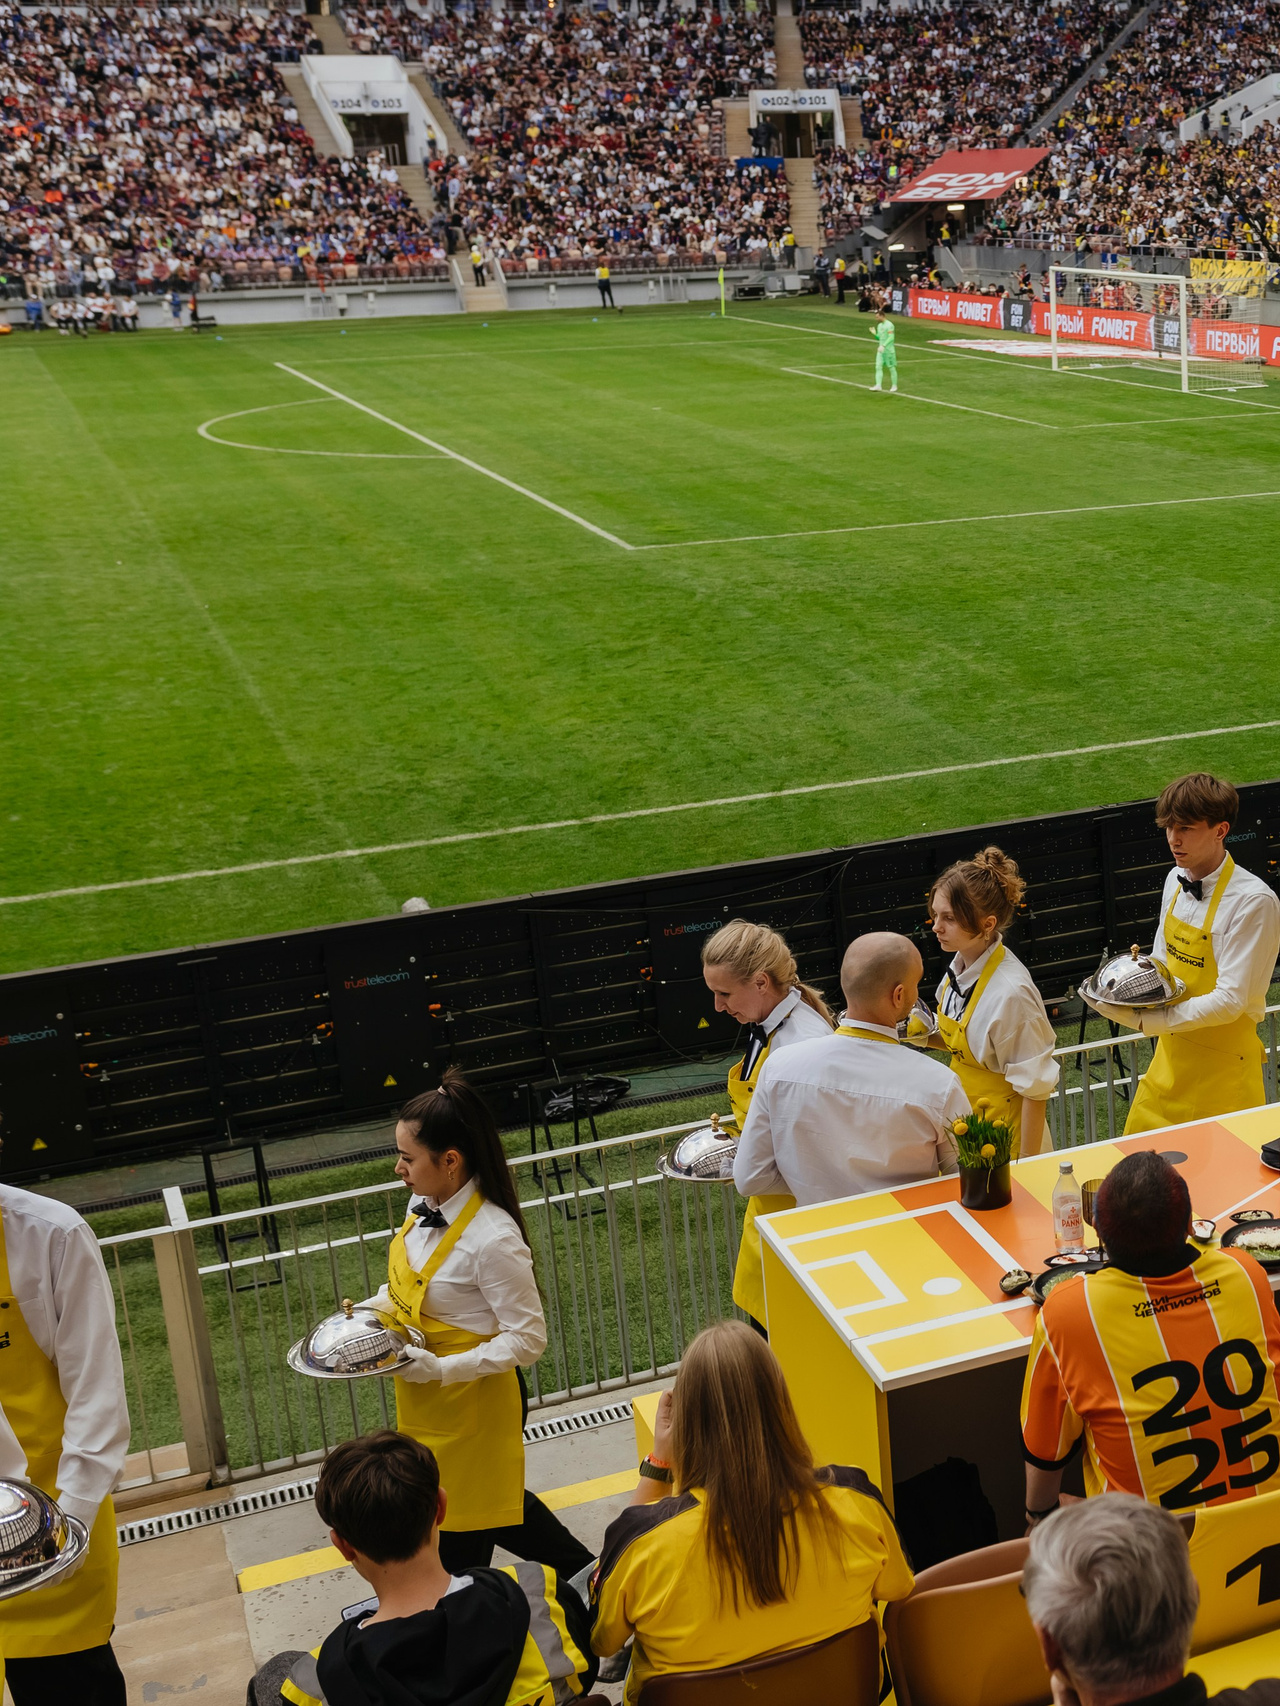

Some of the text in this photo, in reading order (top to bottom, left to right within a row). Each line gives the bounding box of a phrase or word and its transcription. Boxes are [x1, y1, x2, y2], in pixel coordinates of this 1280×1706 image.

[341, 99, 361, 109] 104
[382, 99, 402, 109] 103
[771, 96, 789, 106] 102
[808, 96, 827, 105] 101
[914, 170, 1023, 187] FON
[897, 184, 1007, 200] BET
[918, 295, 993, 322] ПЕРВЫЙ FONBET
[1011, 303, 1023, 315] FON
[1010, 315, 1023, 328] BET
[1044, 310, 1138, 342] ПРВЫЙ FONBET
[1163, 320, 1179, 334] FON
[1163, 333, 1179, 348] BET
[1206, 329, 1260, 356] ПЕРВЫЙ
[344, 972, 410, 990] trusttelecom
[1134, 1287, 1222, 1319] ЧЕМПИОНОВ
[1131, 1338, 1267, 1437] 20
[1151, 1407, 1280, 1511] 25
